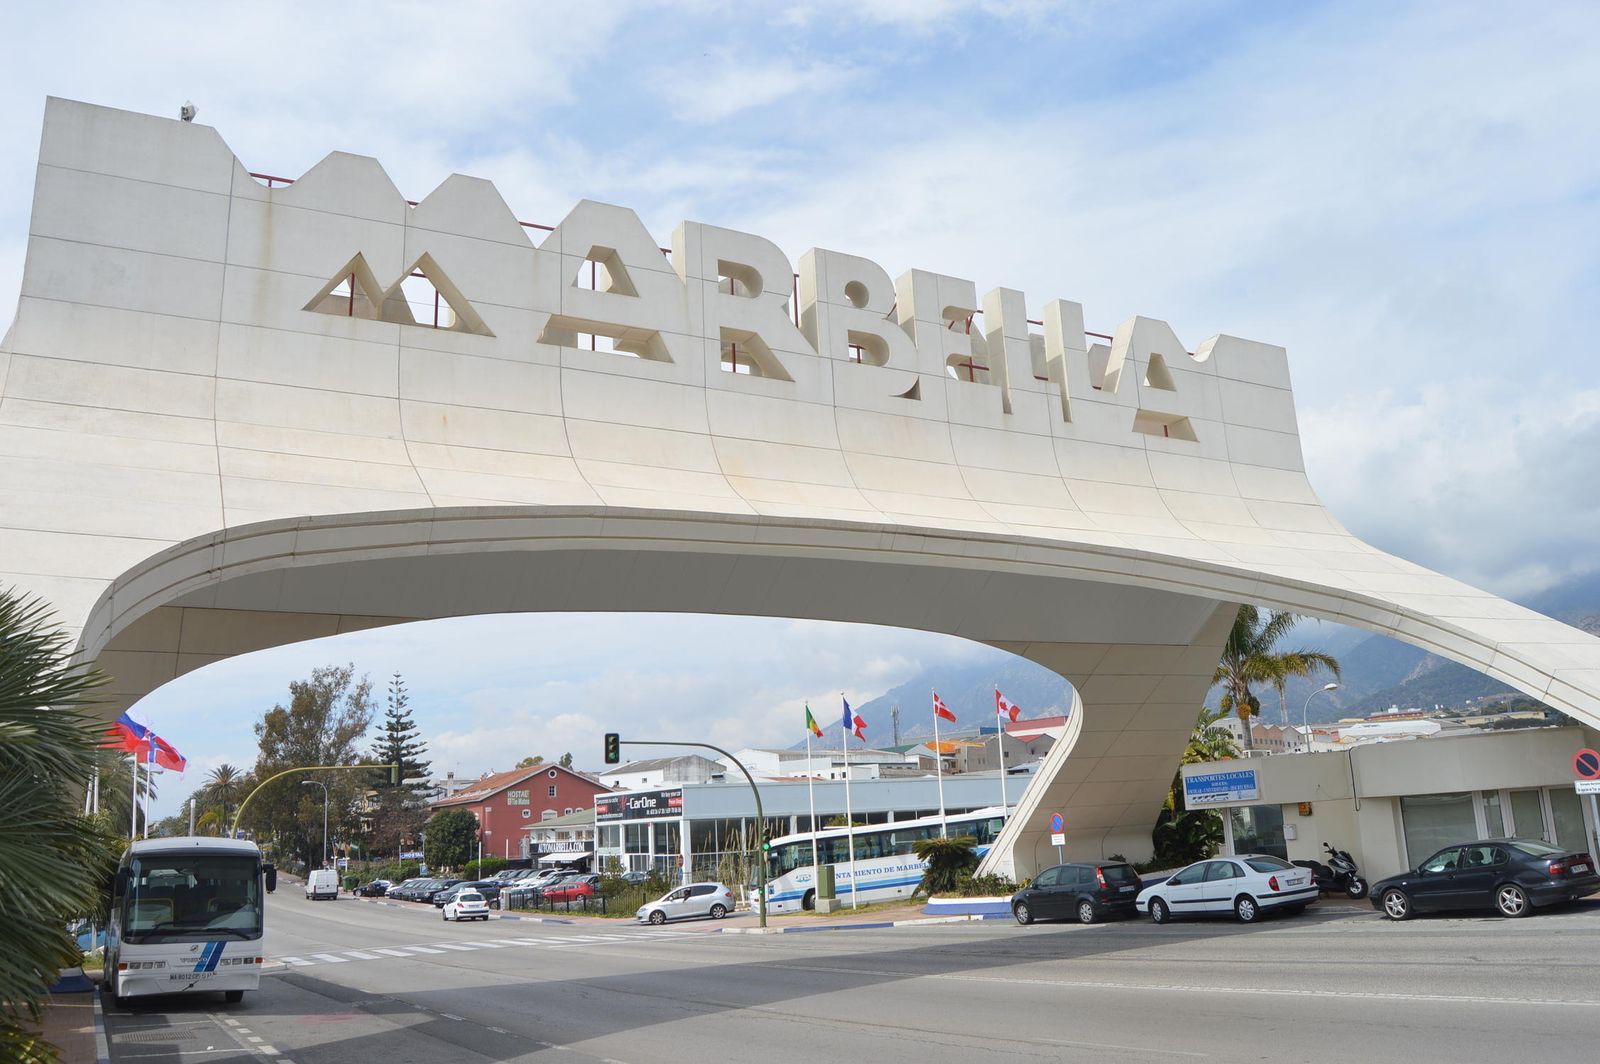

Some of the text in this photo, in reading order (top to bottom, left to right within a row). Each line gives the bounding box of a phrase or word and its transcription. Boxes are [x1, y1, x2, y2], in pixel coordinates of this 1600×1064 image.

[288, 150, 1205, 445] MARBELLA
[1187, 772, 1254, 783] TRANSPORTES LOCALES
[507, 790, 529, 798] HOSTAL
[835, 868, 882, 879] NTAMIENTO
